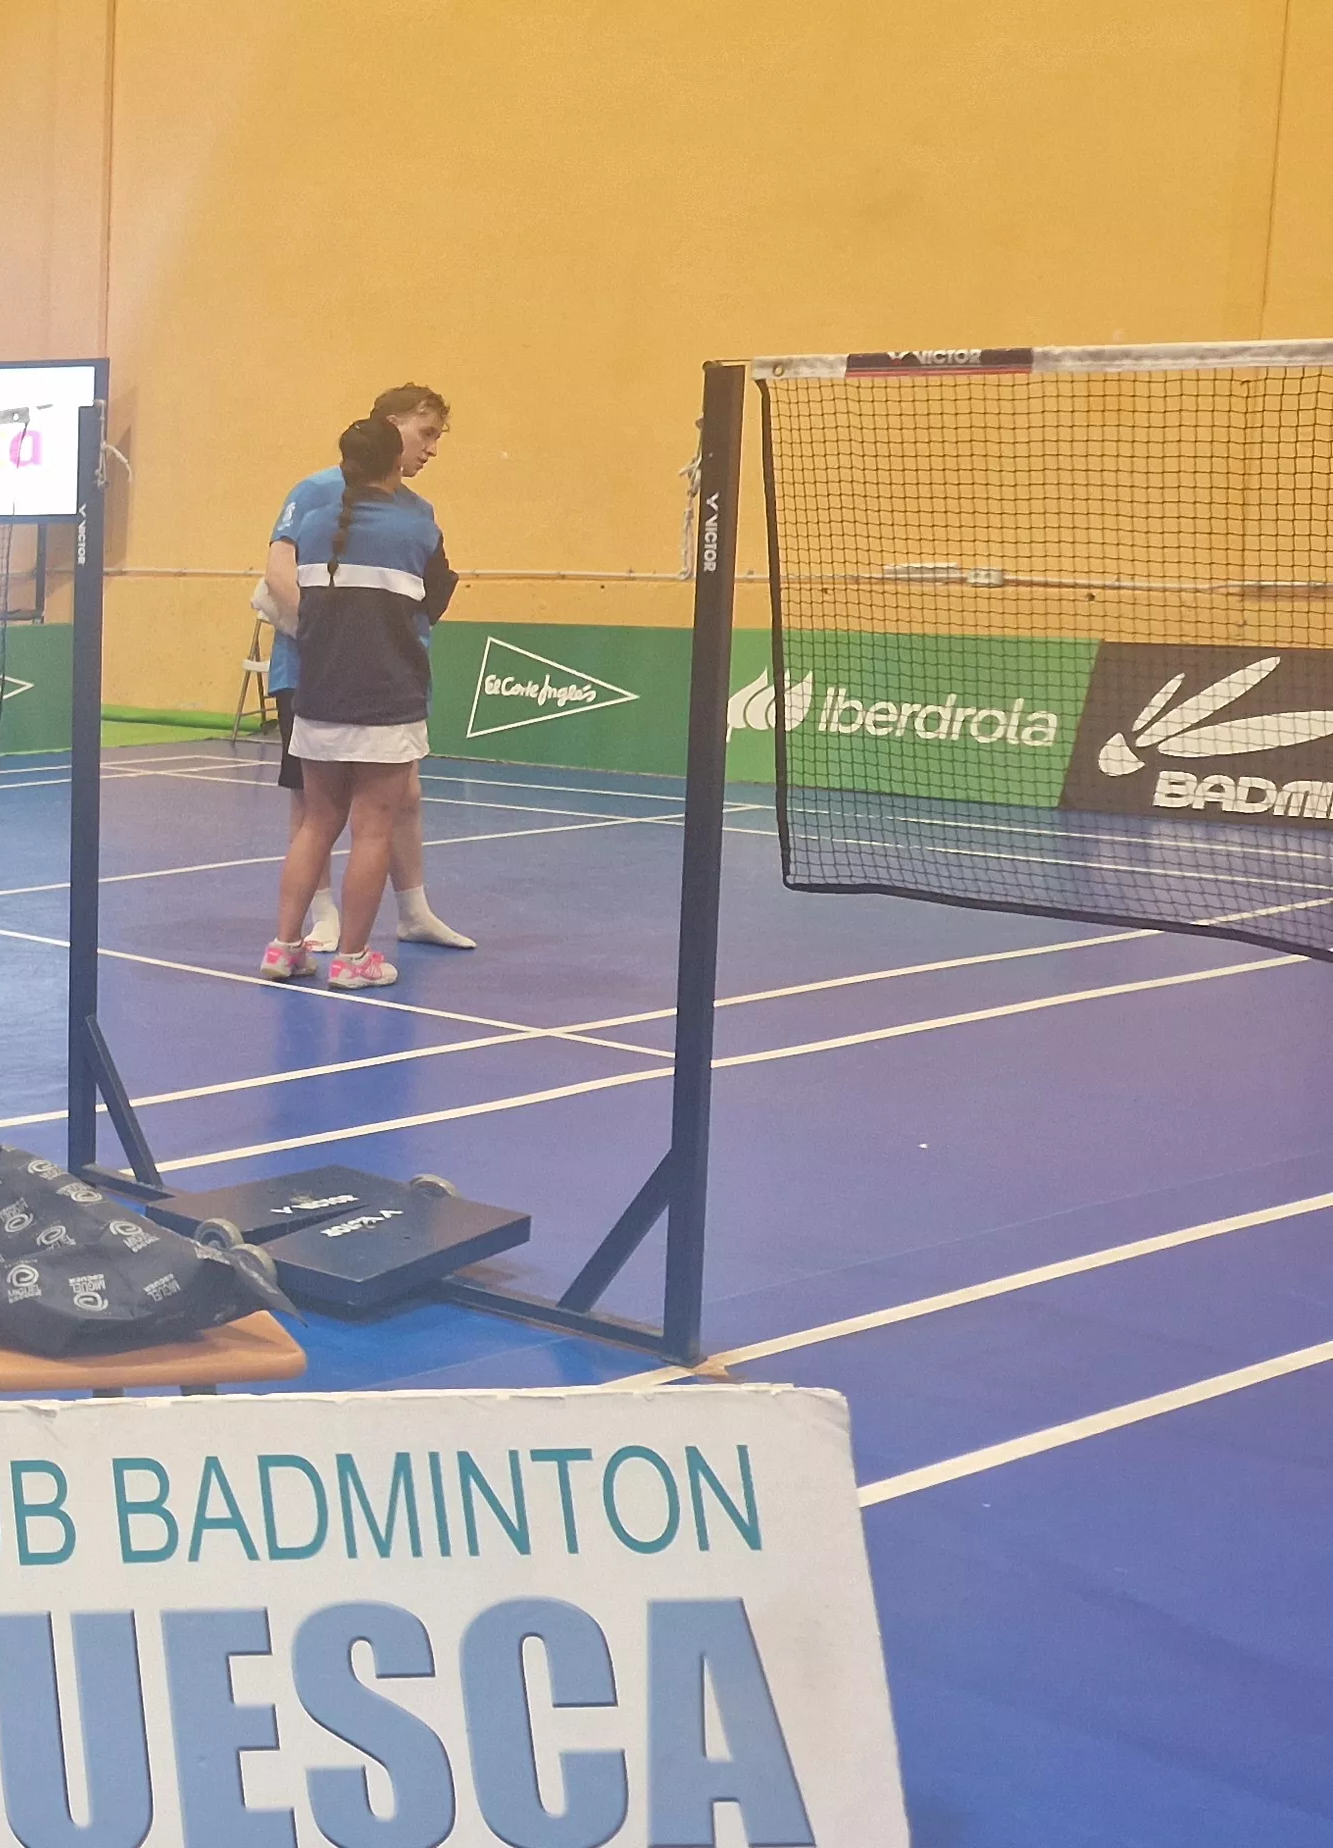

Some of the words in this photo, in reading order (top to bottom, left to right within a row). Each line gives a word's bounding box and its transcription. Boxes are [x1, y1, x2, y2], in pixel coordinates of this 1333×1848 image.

[910, 349, 982, 365] VICTOR
[77, 519, 86, 567] VICTOR
[703, 513, 719, 573] VICTOR
[485, 675, 501, 695] El
[501, 677, 539, 698] Corte
[538, 674, 597, 707] Inglés
[818, 686, 1058, 748] Iberdrola
[110, 1444, 763, 1564] BADMINTON
